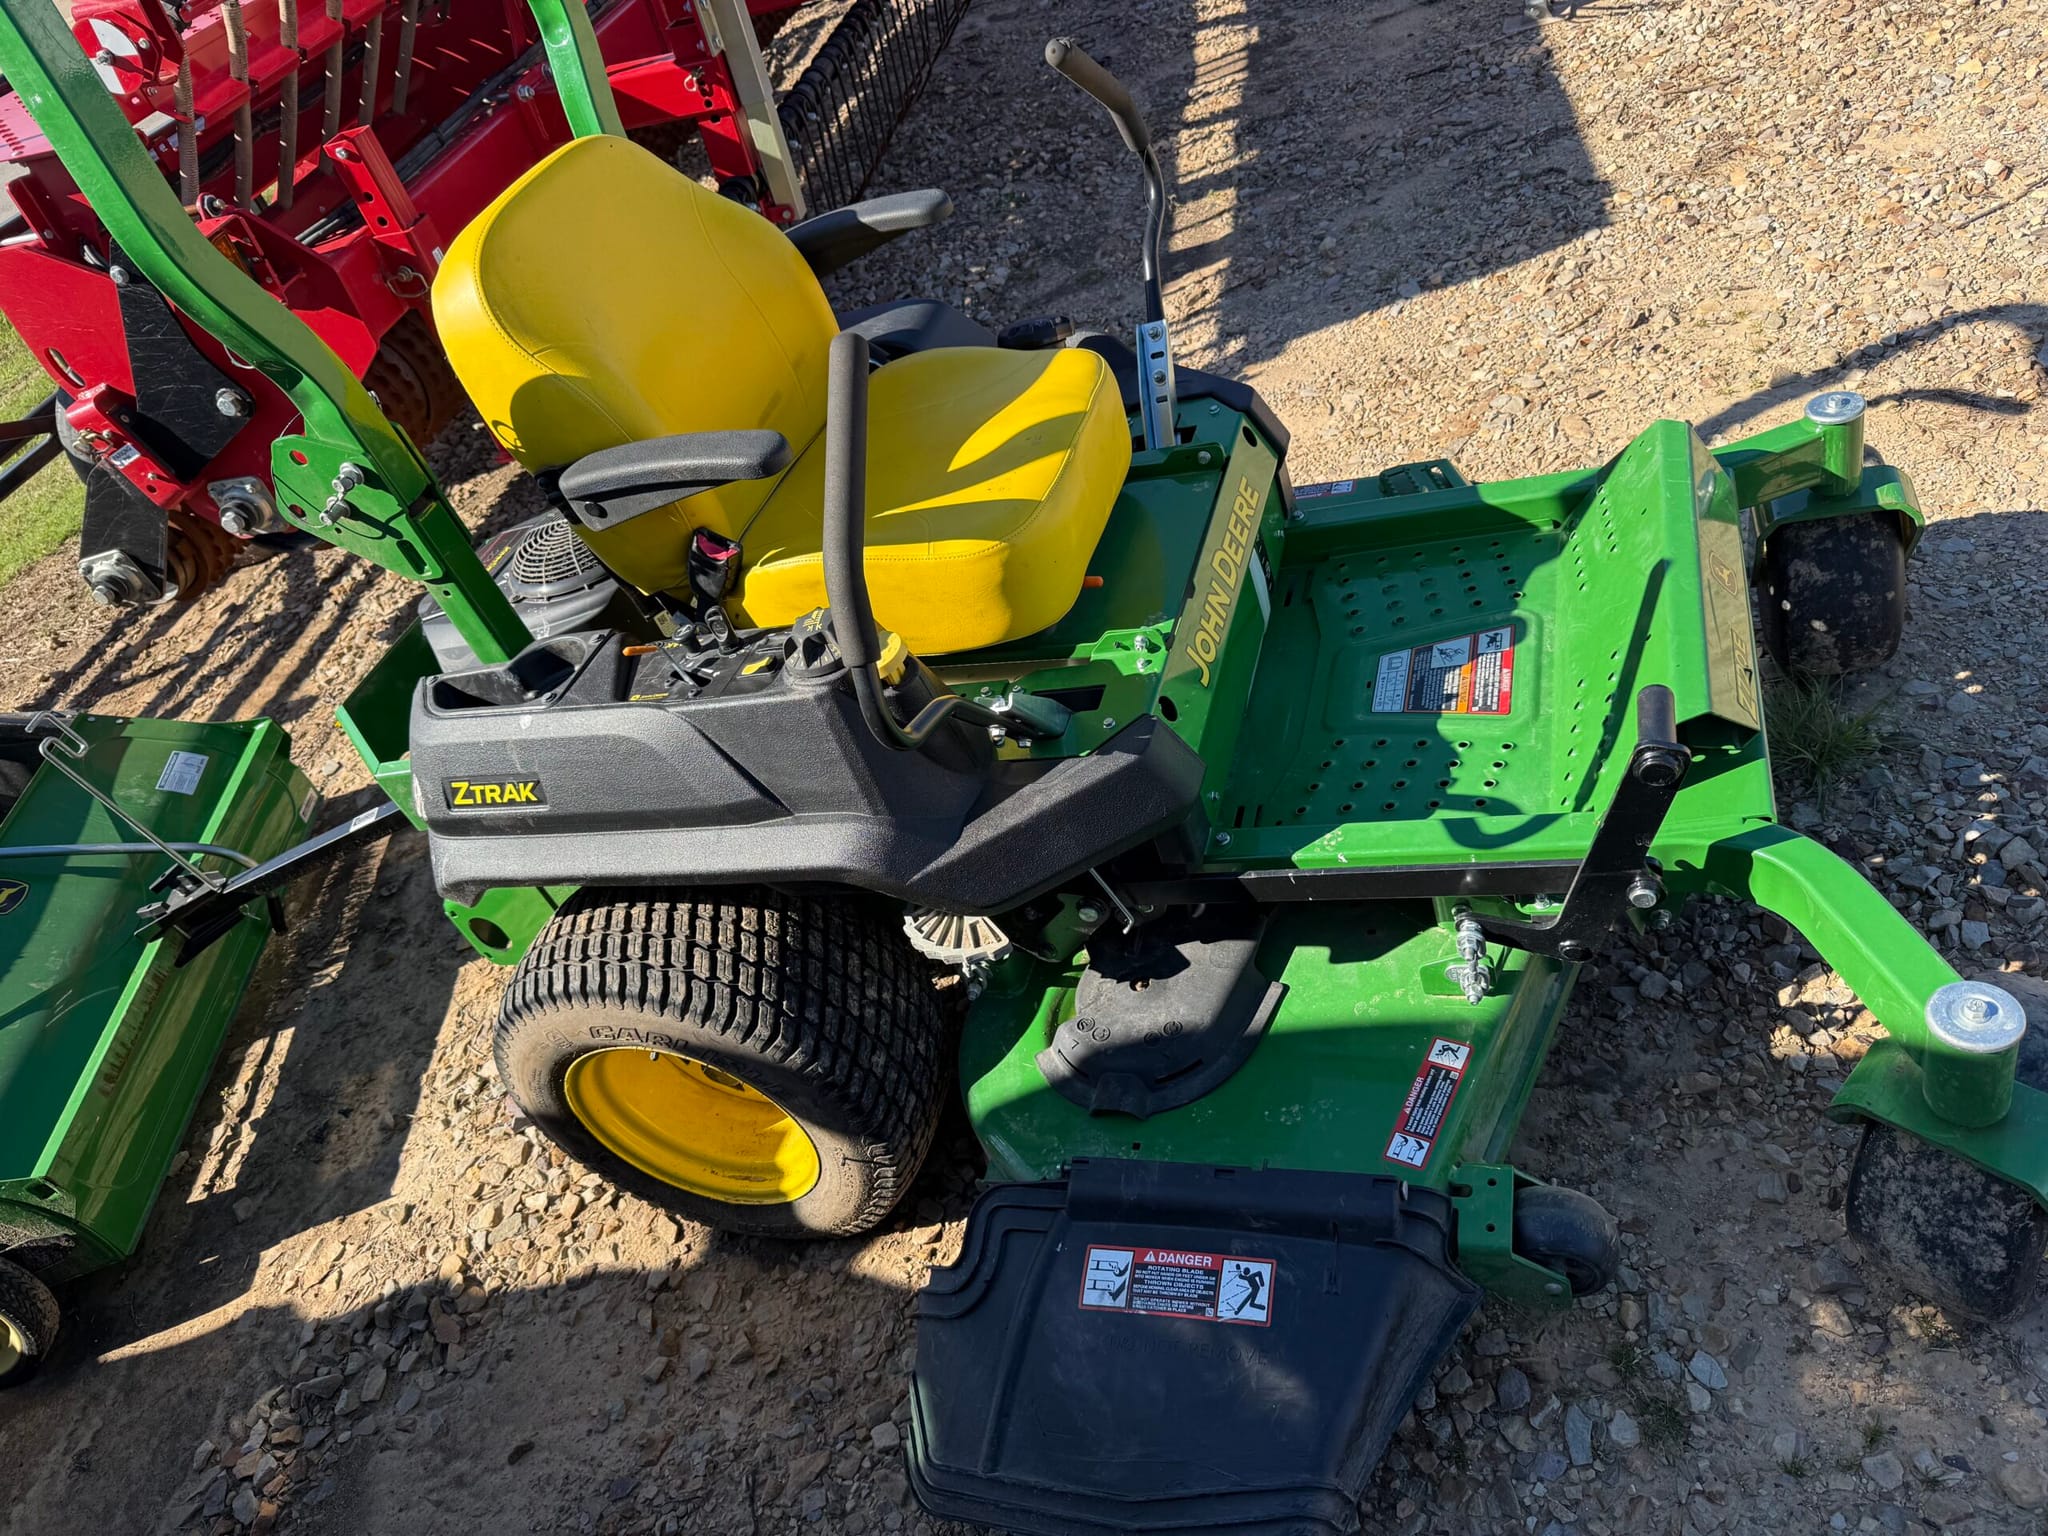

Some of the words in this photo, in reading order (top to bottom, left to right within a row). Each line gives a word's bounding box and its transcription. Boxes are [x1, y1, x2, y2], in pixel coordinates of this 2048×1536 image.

[1186, 580, 1231, 687] JOHN
[1211, 475, 1260, 589] DEERE
[450, 780, 539, 806] ZTRAK
[1404, 1075, 1424, 1107] DANGER
[1147, 1264, 1180, 1273] ROTATING
[1181, 1267, 1204, 1275] BLADE
[1157, 1251, 1213, 1267] DANGER
[1143, 1279, 1172, 1287] THROWN
[1172, 1281, 1204, 1289] OBJECTS
